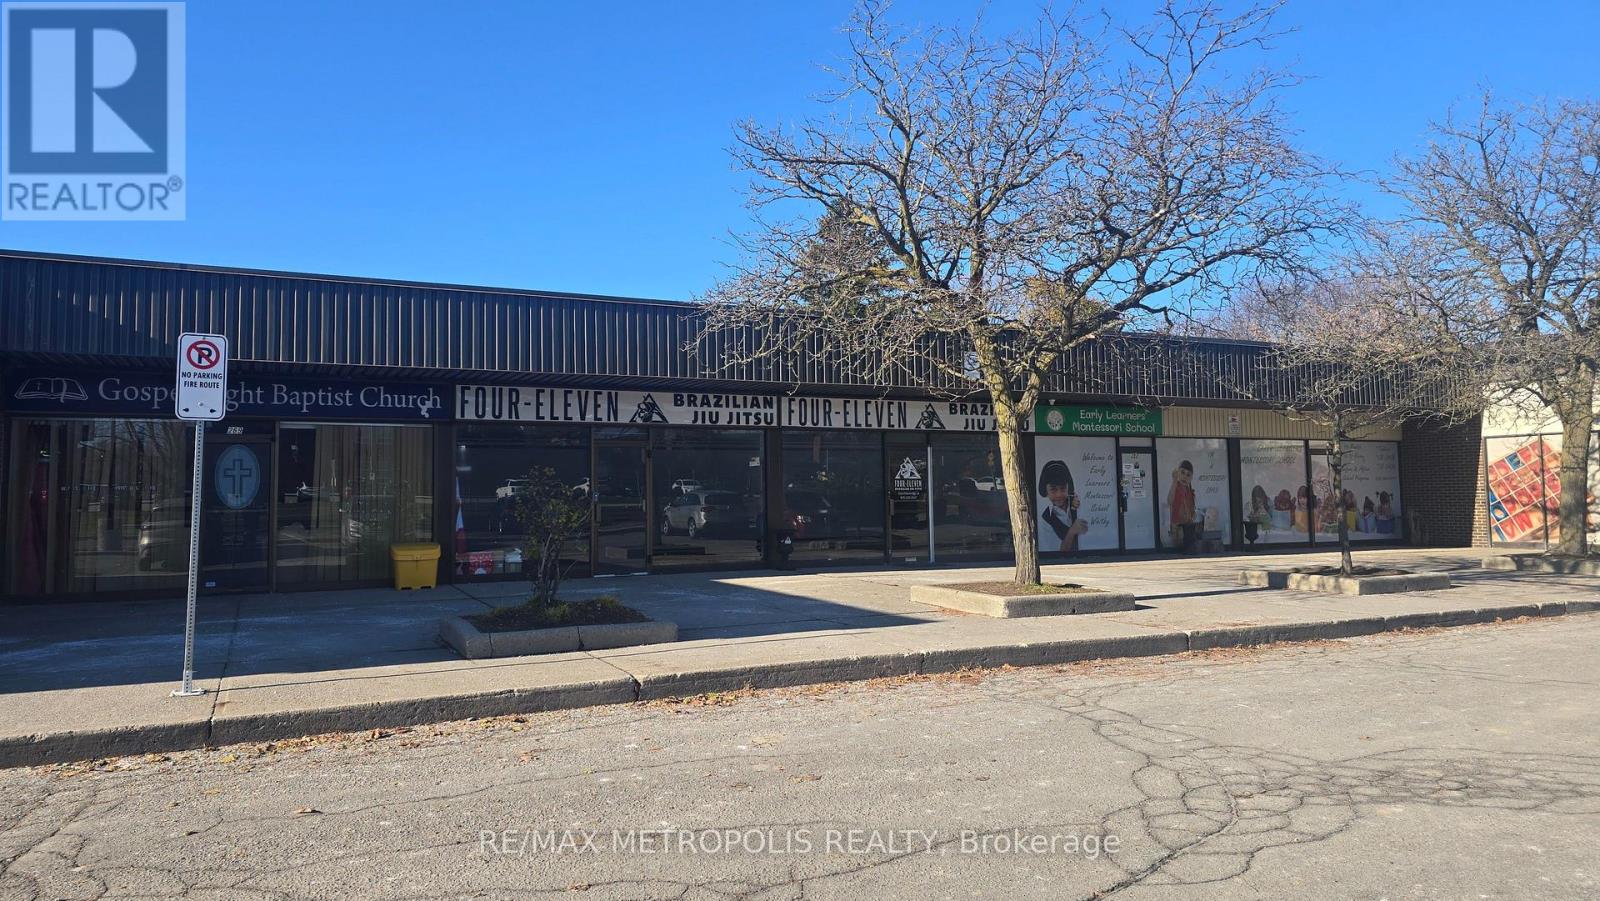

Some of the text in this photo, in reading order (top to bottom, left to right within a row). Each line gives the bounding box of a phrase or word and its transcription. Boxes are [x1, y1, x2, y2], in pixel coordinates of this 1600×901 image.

[181, 371, 223, 380] NO PARKING
[184, 380, 220, 389] FIRE ROUTE
[226, 381, 264, 412] ght
[271, 384, 353, 412] Baptist
[359, 386, 442, 410] Church
[673, 393, 774, 409] BRAZILIAN
[460, 385, 619, 422] FOUR-ELEVEN
[949, 403, 993, 416] BRAZI
[692, 411, 774, 426] JIU JITSU
[788, 397, 907, 428] FOUR-ELEVEN
[1079, 409, 1103, 422] Early
[963, 418, 986, 430] JIU
[1072, 421, 1156, 433] Montessori School
